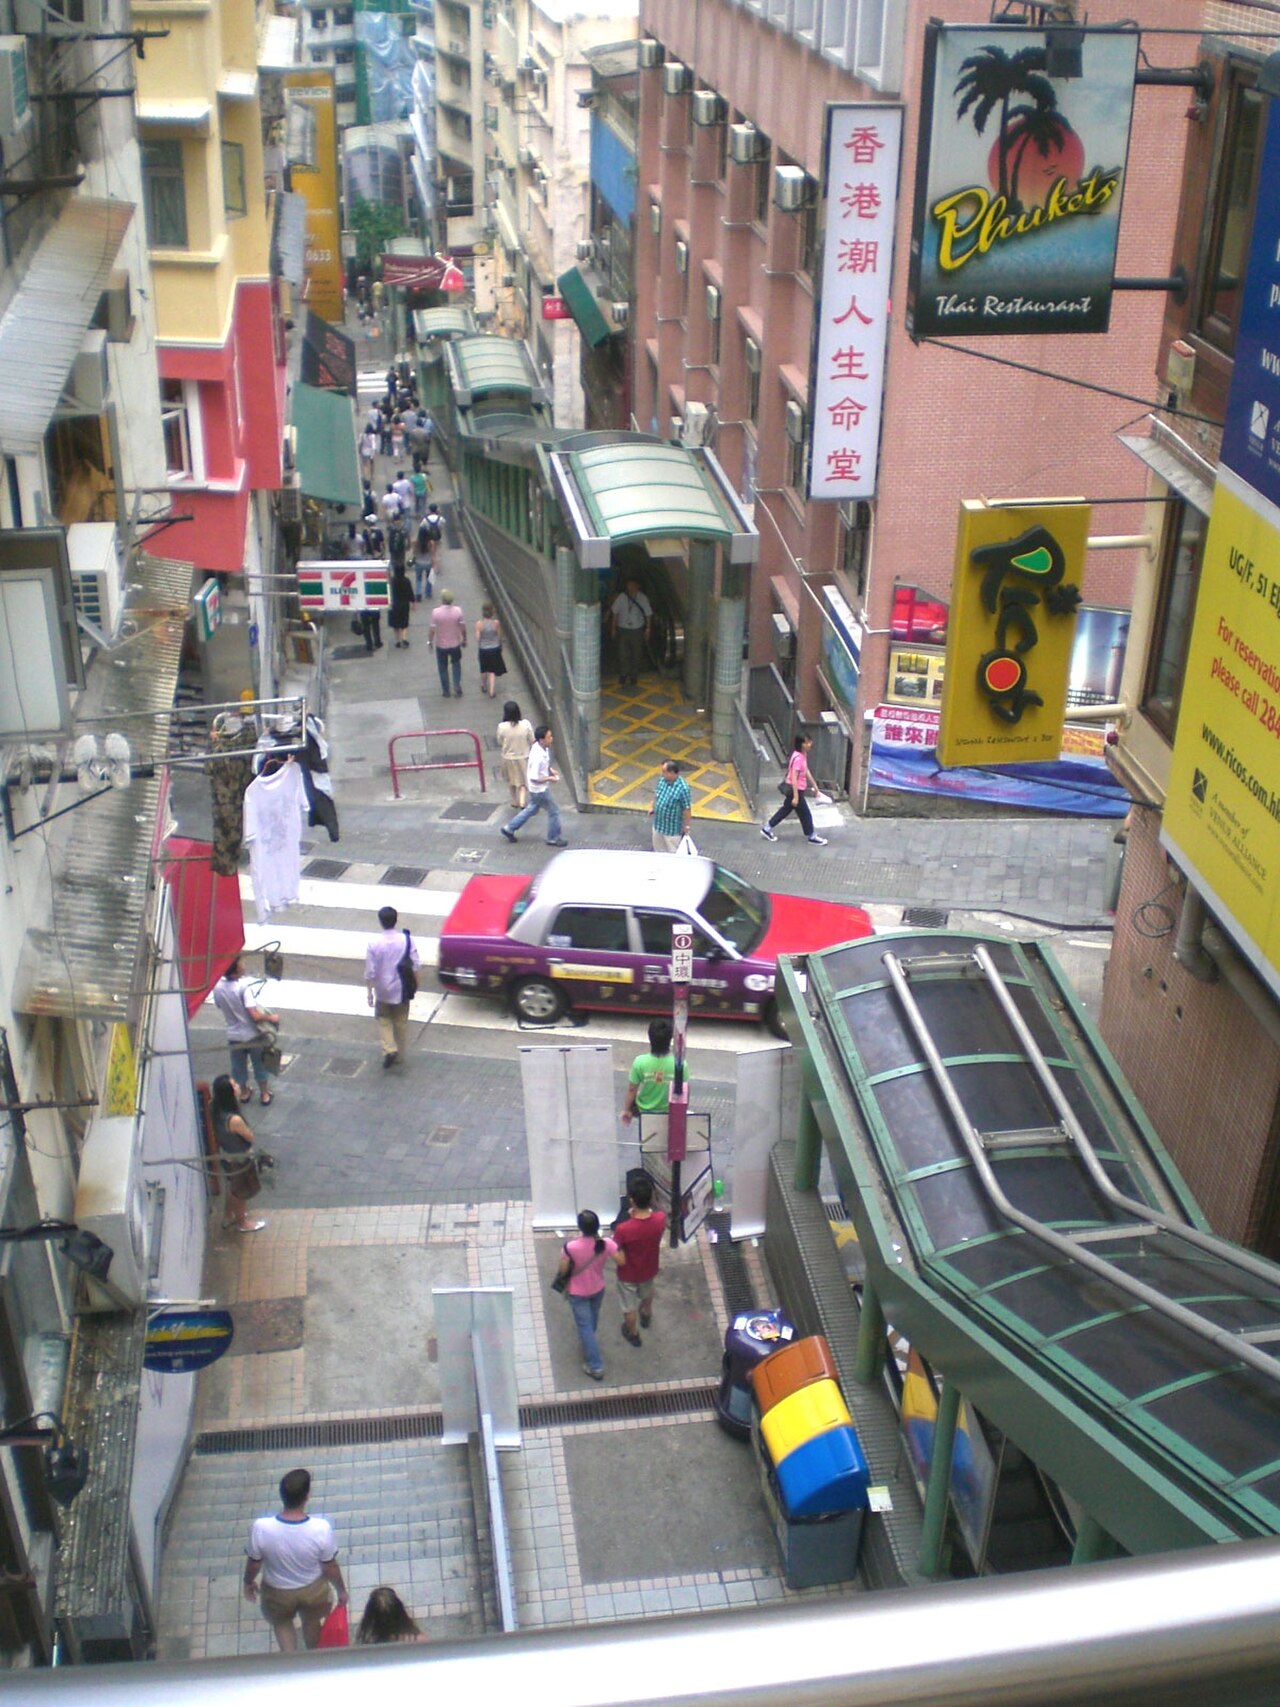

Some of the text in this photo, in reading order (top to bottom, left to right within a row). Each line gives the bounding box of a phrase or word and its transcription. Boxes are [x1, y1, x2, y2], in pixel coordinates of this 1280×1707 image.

[933, 167, 1119, 270] Phukets
[825, 126, 885, 481] 香港潮人生命堂
[936, 295, 1092, 316] Thai Restaurant
[1217, 615, 1233, 645] For
[1211, 656, 1240, 697] please
[1241, 687, 1259, 715] call
